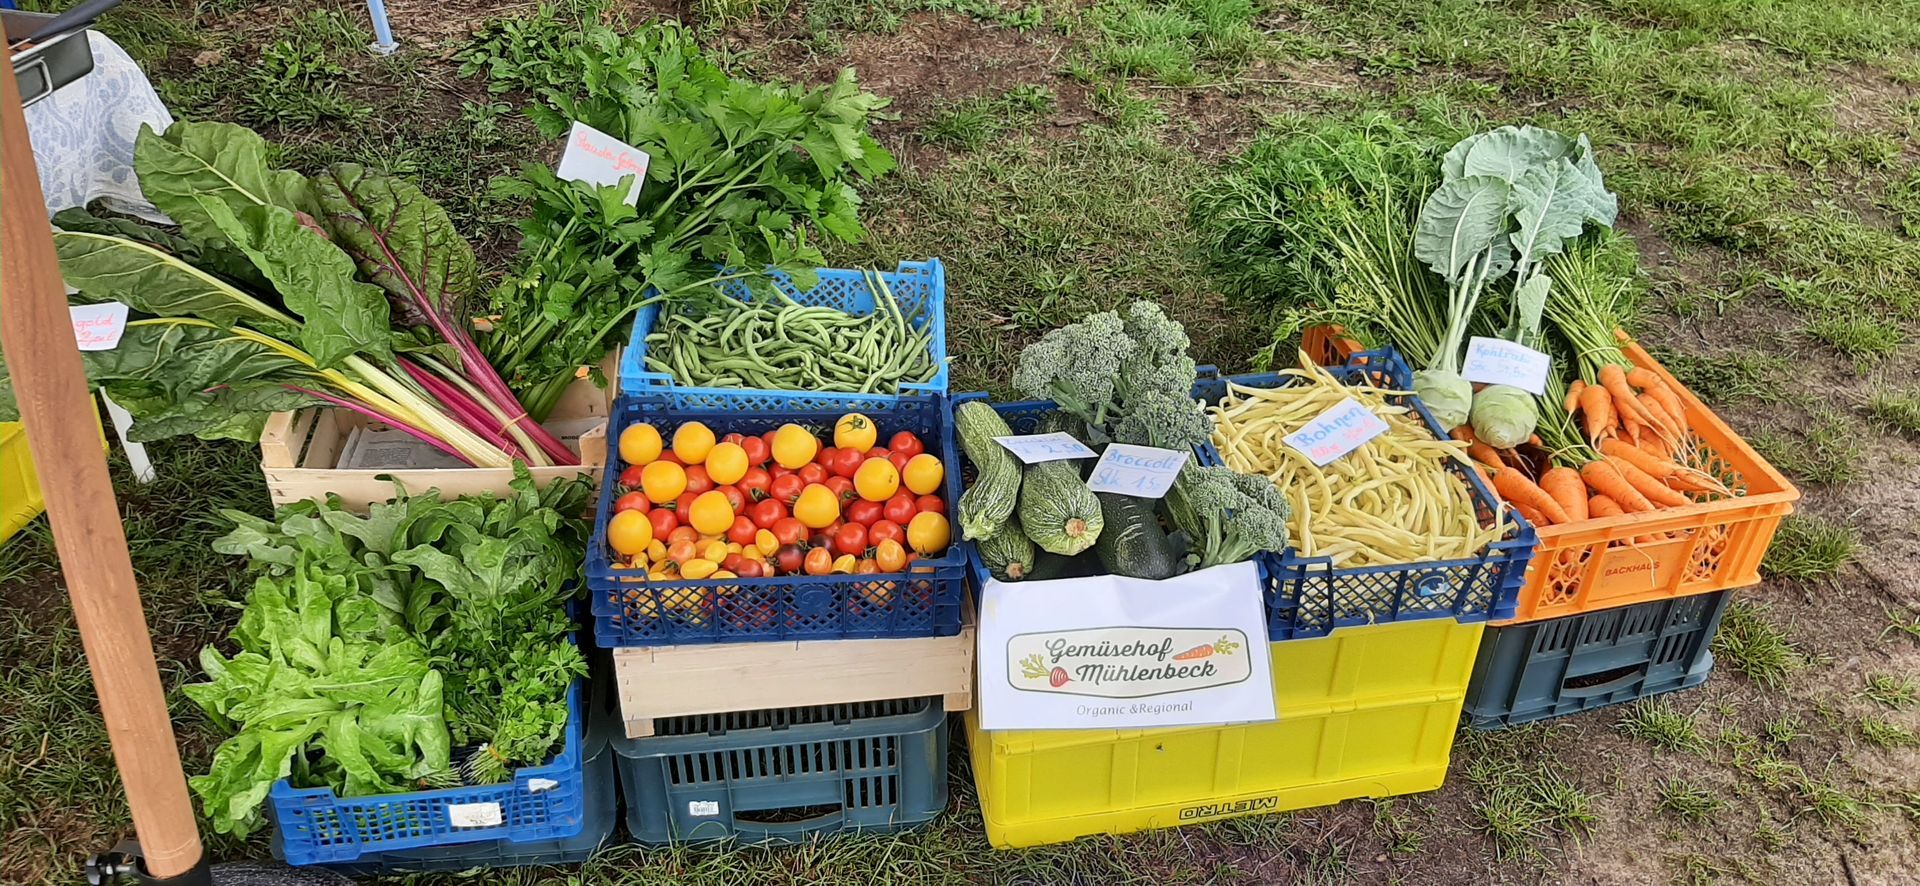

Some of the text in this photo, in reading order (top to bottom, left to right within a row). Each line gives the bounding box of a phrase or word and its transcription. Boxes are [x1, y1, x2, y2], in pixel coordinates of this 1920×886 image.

[1293, 407, 1366, 447] Bohnen
[1105, 449, 1178, 469] Broccoli
[1605, 562, 1660, 576] BACKHAUS
[1045, 637, 1174, 664] Gemüsehof
[1076, 660, 1218, 685] Mühlenbeck
[1076, 701, 1193, 717] Organic &Regional
[1179, 796, 1278, 820] METRO
